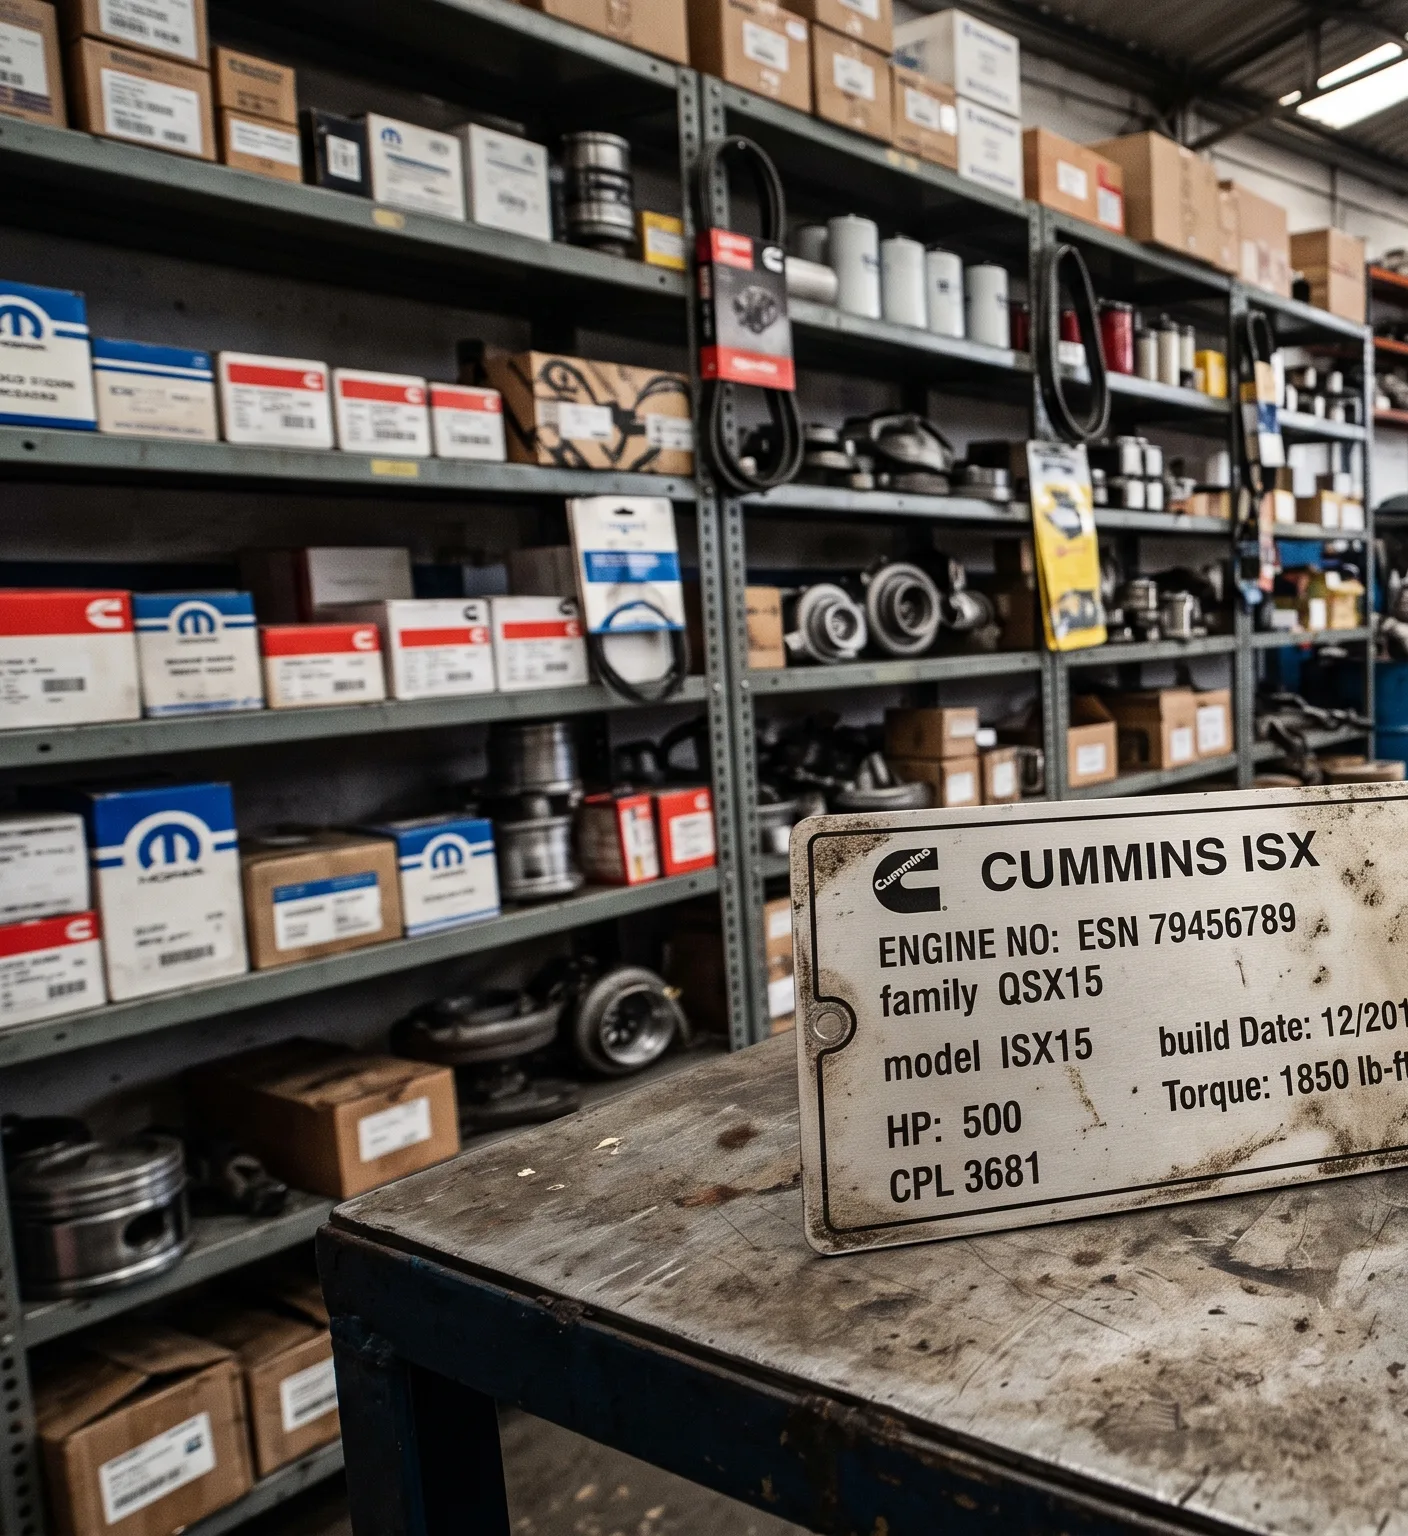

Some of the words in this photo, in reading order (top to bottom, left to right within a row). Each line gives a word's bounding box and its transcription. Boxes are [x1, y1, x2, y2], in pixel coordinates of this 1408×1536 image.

[873, 847, 931, 892] Cummins
[982, 837, 1226, 891] CUMMINS
[1243, 830, 1320, 872] ISX
[879, 928, 996, 968] ENGINE
[1007, 924, 1058, 957] NO:
[1078, 916, 1138, 951] ESN
[1149, 903, 1295, 944] 79456789
[880, 978, 977, 1017] family
[999, 965, 1102, 1005] QSX15
[885, 1040, 980, 1082] model
[1001, 1027, 1092, 1068] ISX15
[1159, 1019, 1229, 1057] build
[1240, 1015, 1311, 1047] Date:
[1162, 1076, 1270, 1112] Torque:
[1280, 1059, 1349, 1096] 1850
[887, 1112, 941, 1148] HP:
[964, 1101, 1021, 1138] 500
[890, 1164, 954, 1203] CPL
[964, 1151, 1039, 1193] 3681
